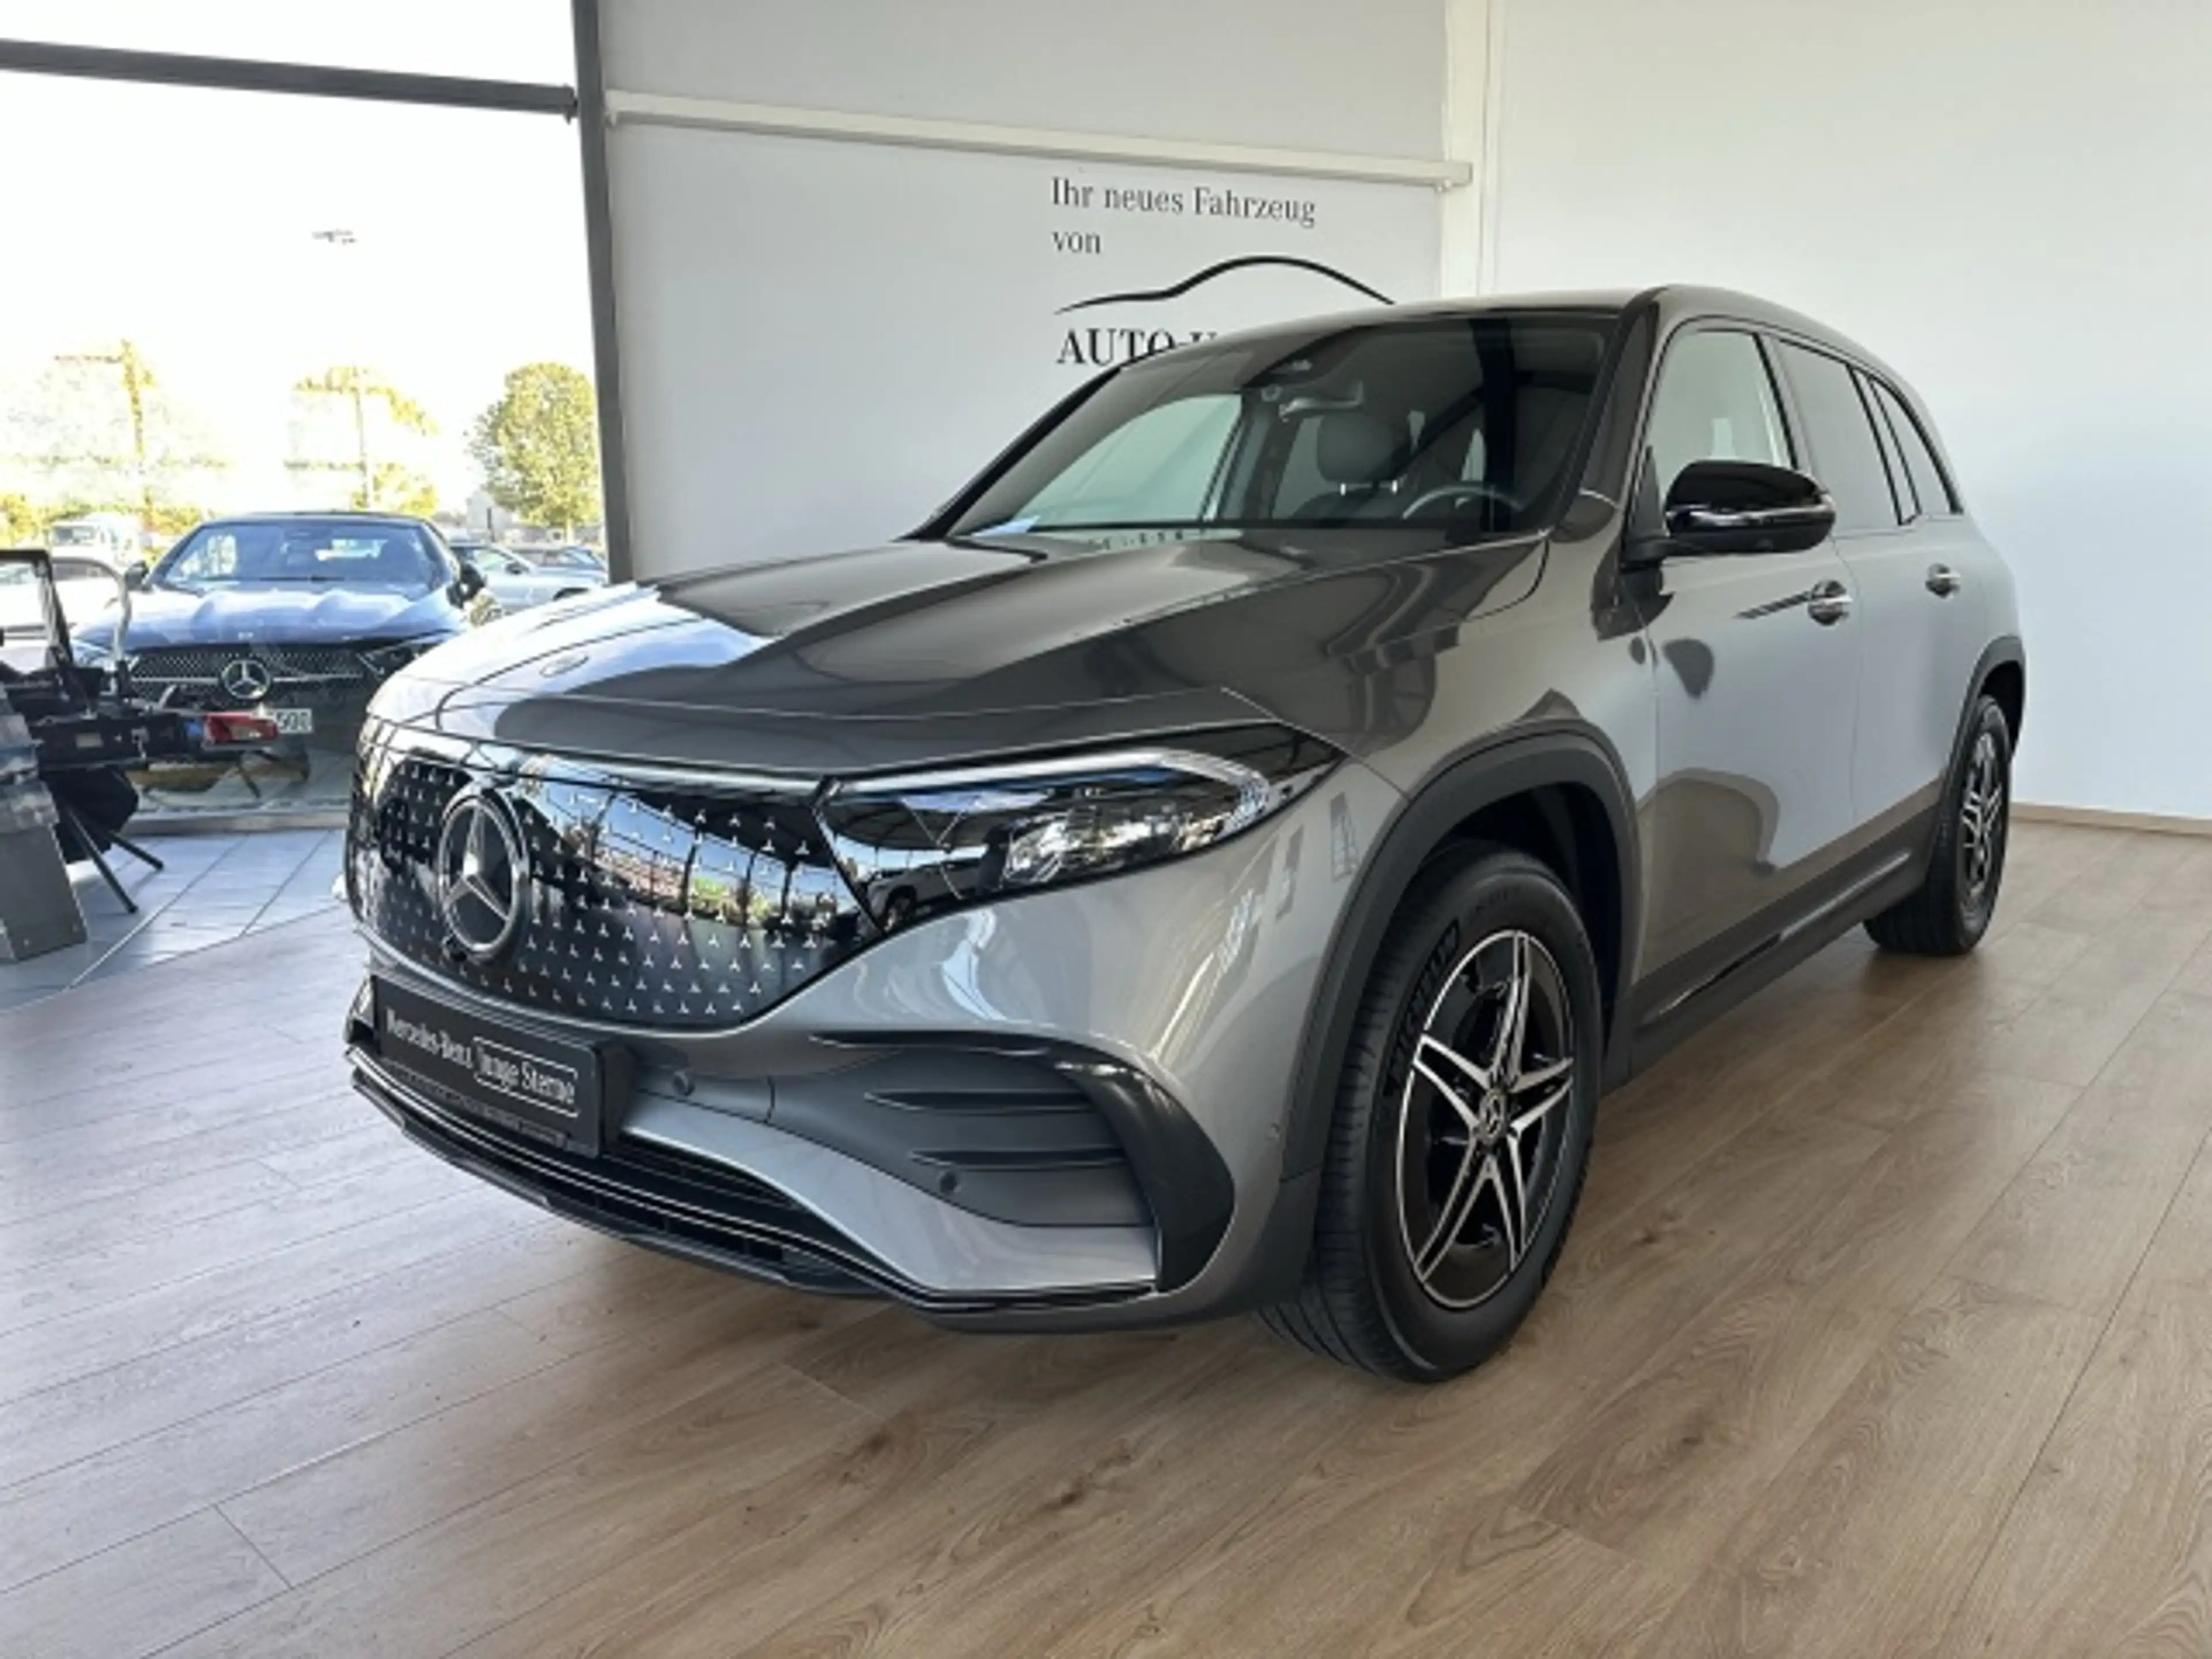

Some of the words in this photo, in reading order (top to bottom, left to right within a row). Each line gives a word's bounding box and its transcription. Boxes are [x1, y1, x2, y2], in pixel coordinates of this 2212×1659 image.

[1052, 177, 1094, 208] Ihr
[1104, 187, 1184, 214] neues
[1194, 187, 1316, 228] Fahrzeug
[1052, 232, 1101, 254] von
